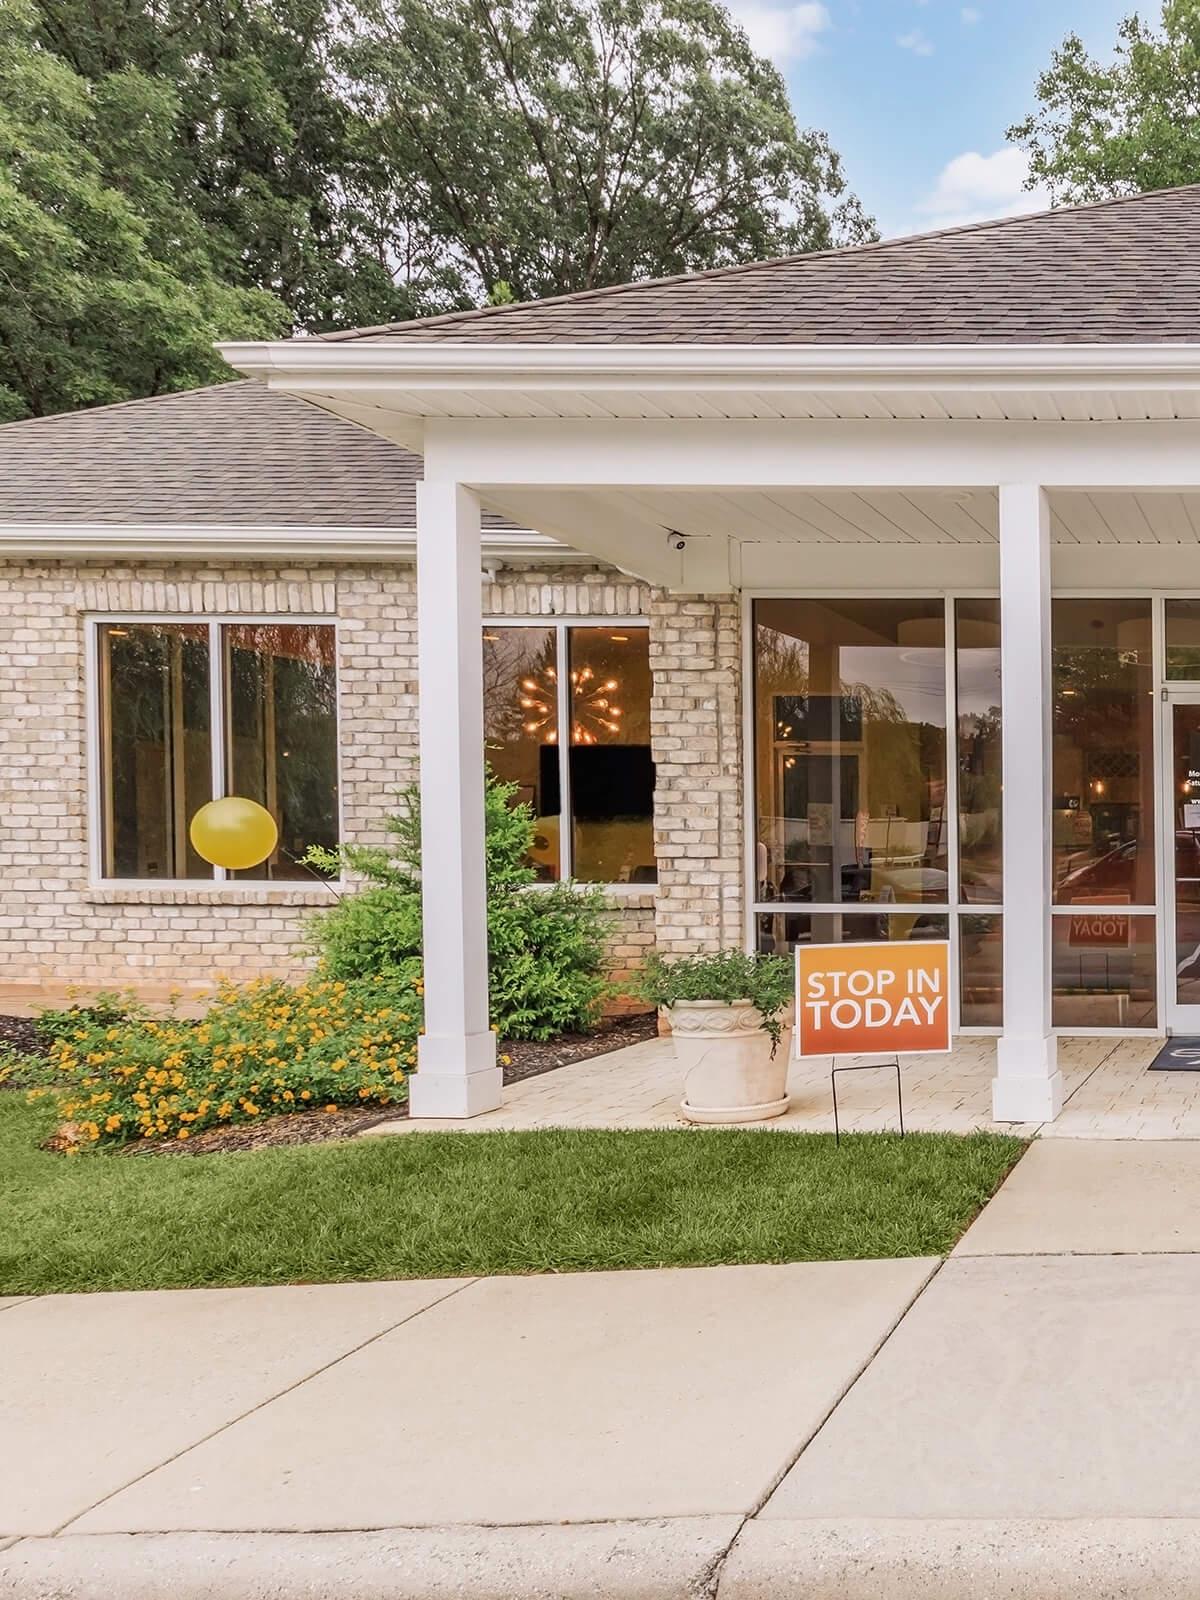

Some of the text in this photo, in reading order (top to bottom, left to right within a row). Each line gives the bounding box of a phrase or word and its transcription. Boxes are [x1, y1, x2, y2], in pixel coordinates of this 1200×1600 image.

[807, 968, 940, 999] STOP IN
[805, 996, 943, 1030] TODAY
